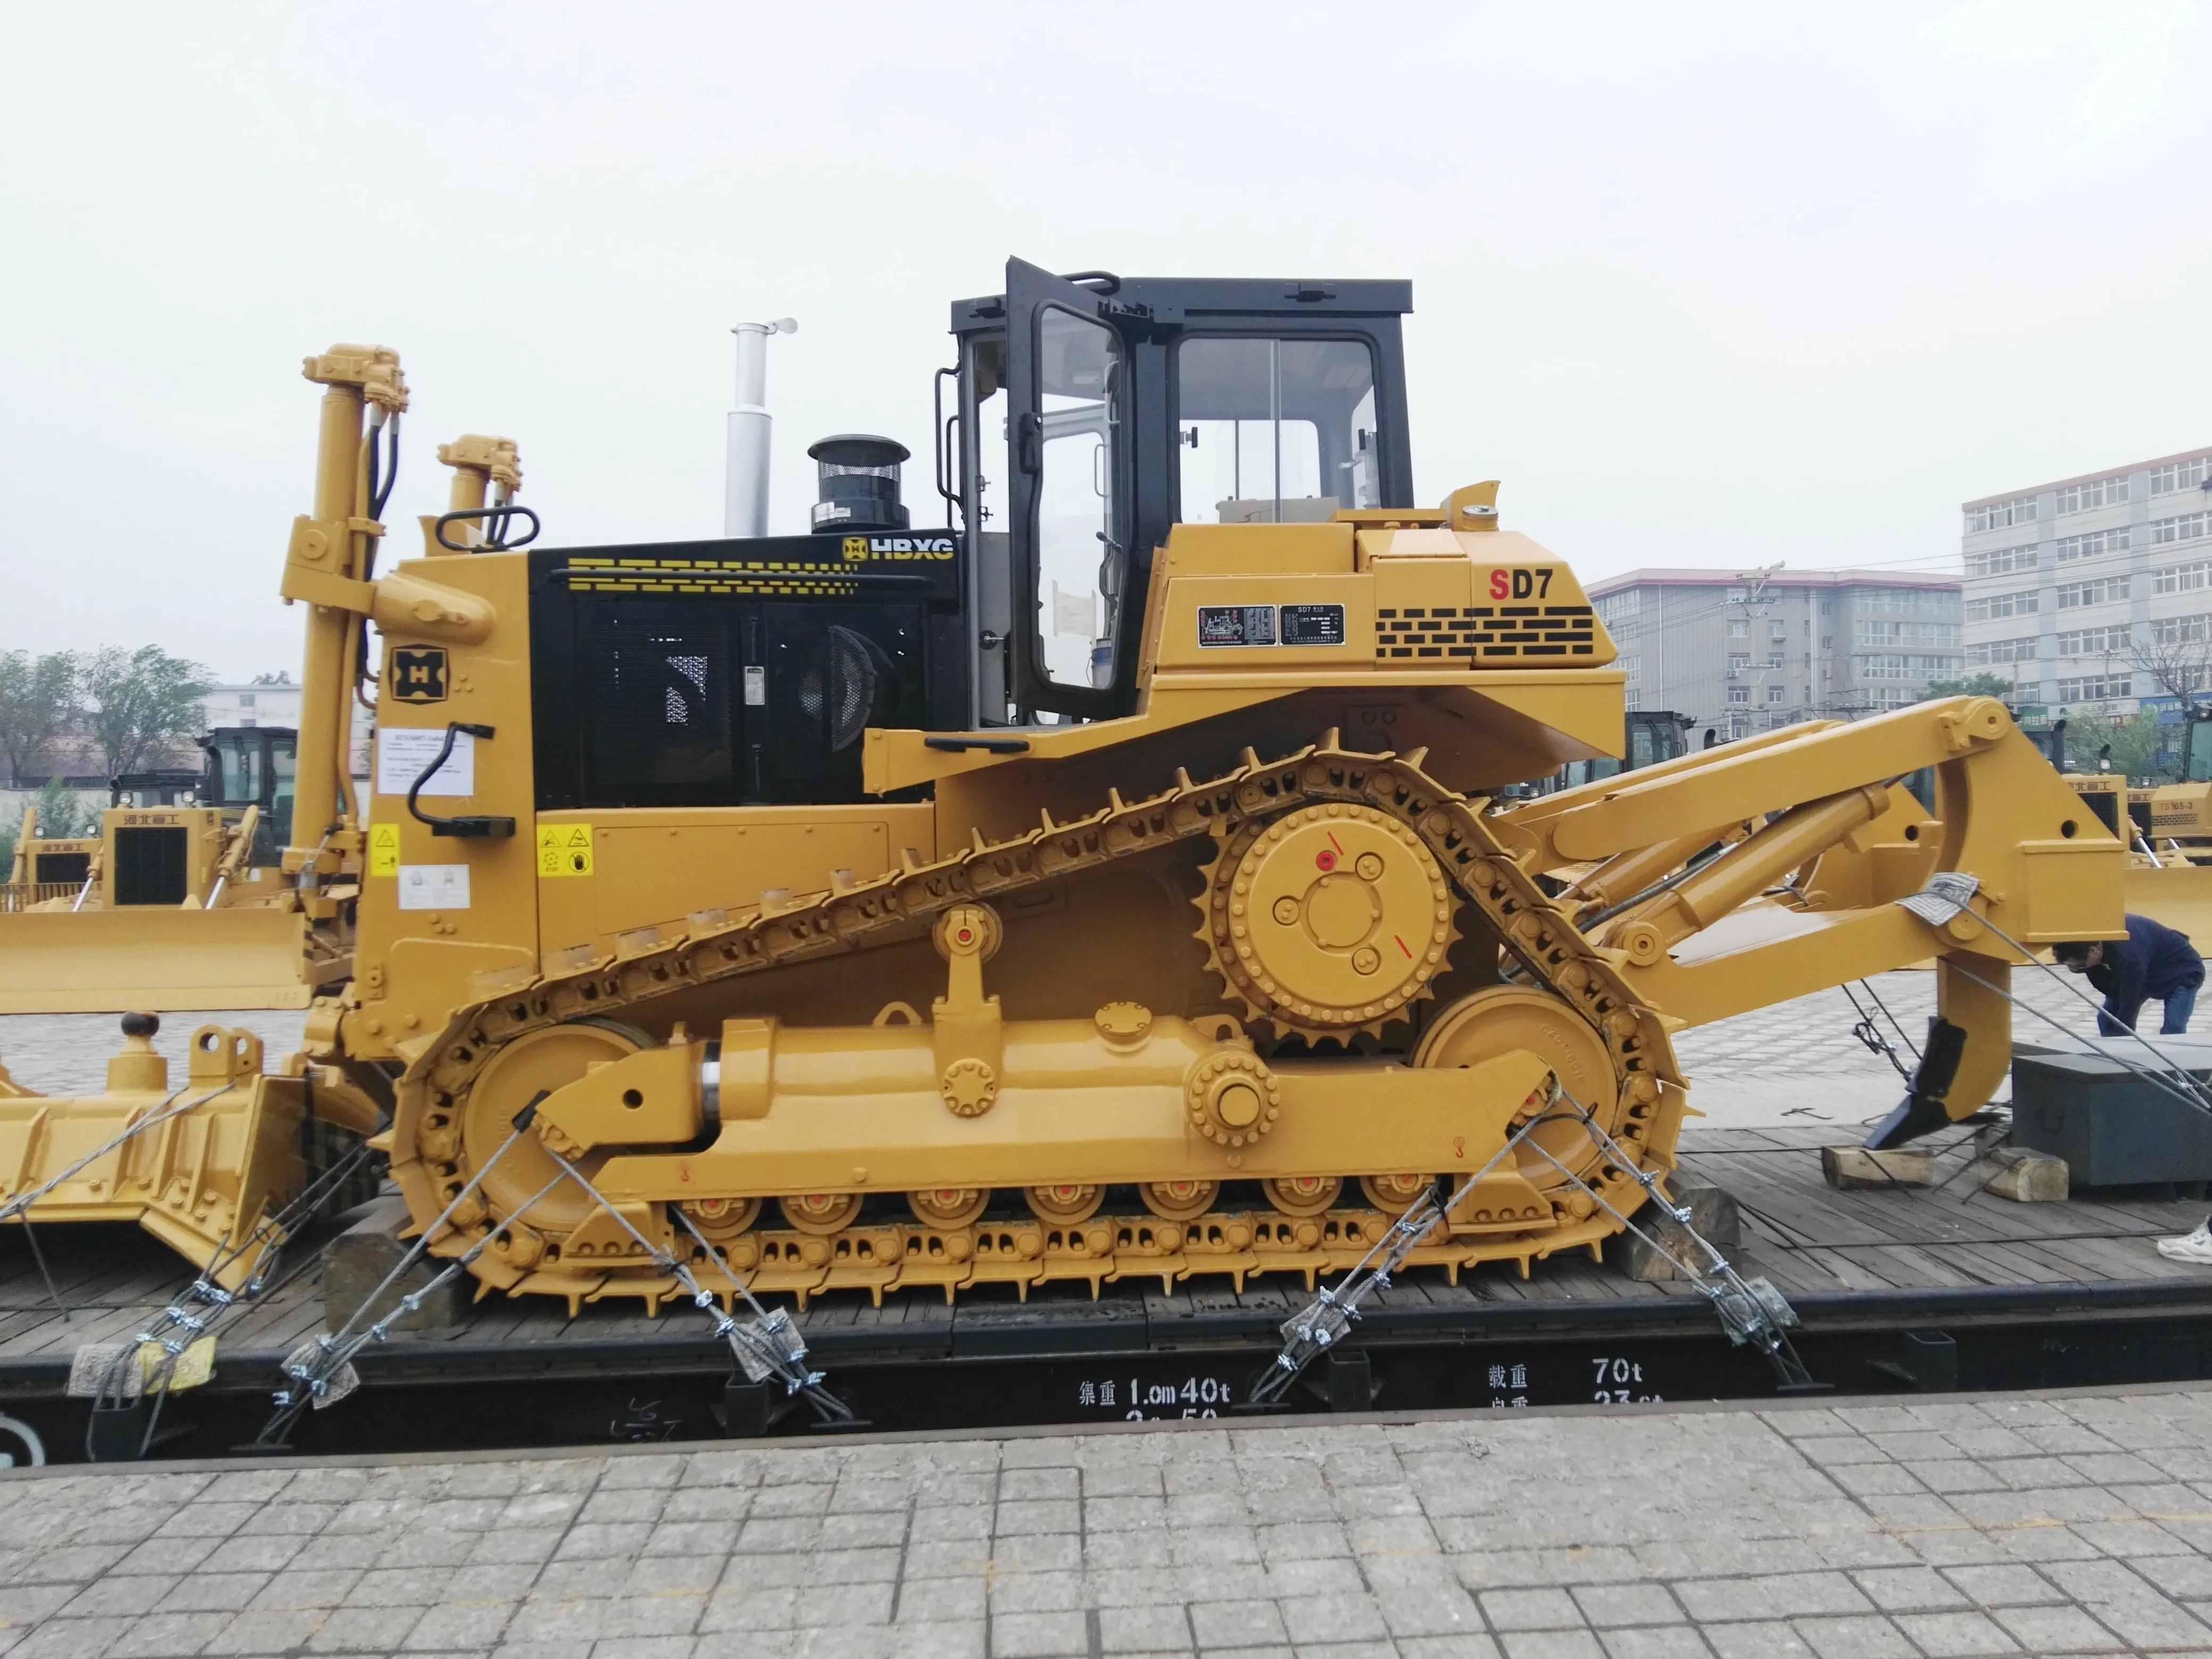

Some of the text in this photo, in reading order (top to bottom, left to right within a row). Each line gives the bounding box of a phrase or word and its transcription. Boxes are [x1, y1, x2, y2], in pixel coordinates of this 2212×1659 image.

[870, 539, 953, 559] HBXG
[1489, 569, 1553, 600] SD7
[2068, 781, 2110, 791] 北宣工
[1489, 1358, 1643, 1388] 载重 70t
[1079, 1379, 1116, 1405] 集重
[1180, 1377, 1230, 1403] 40t
